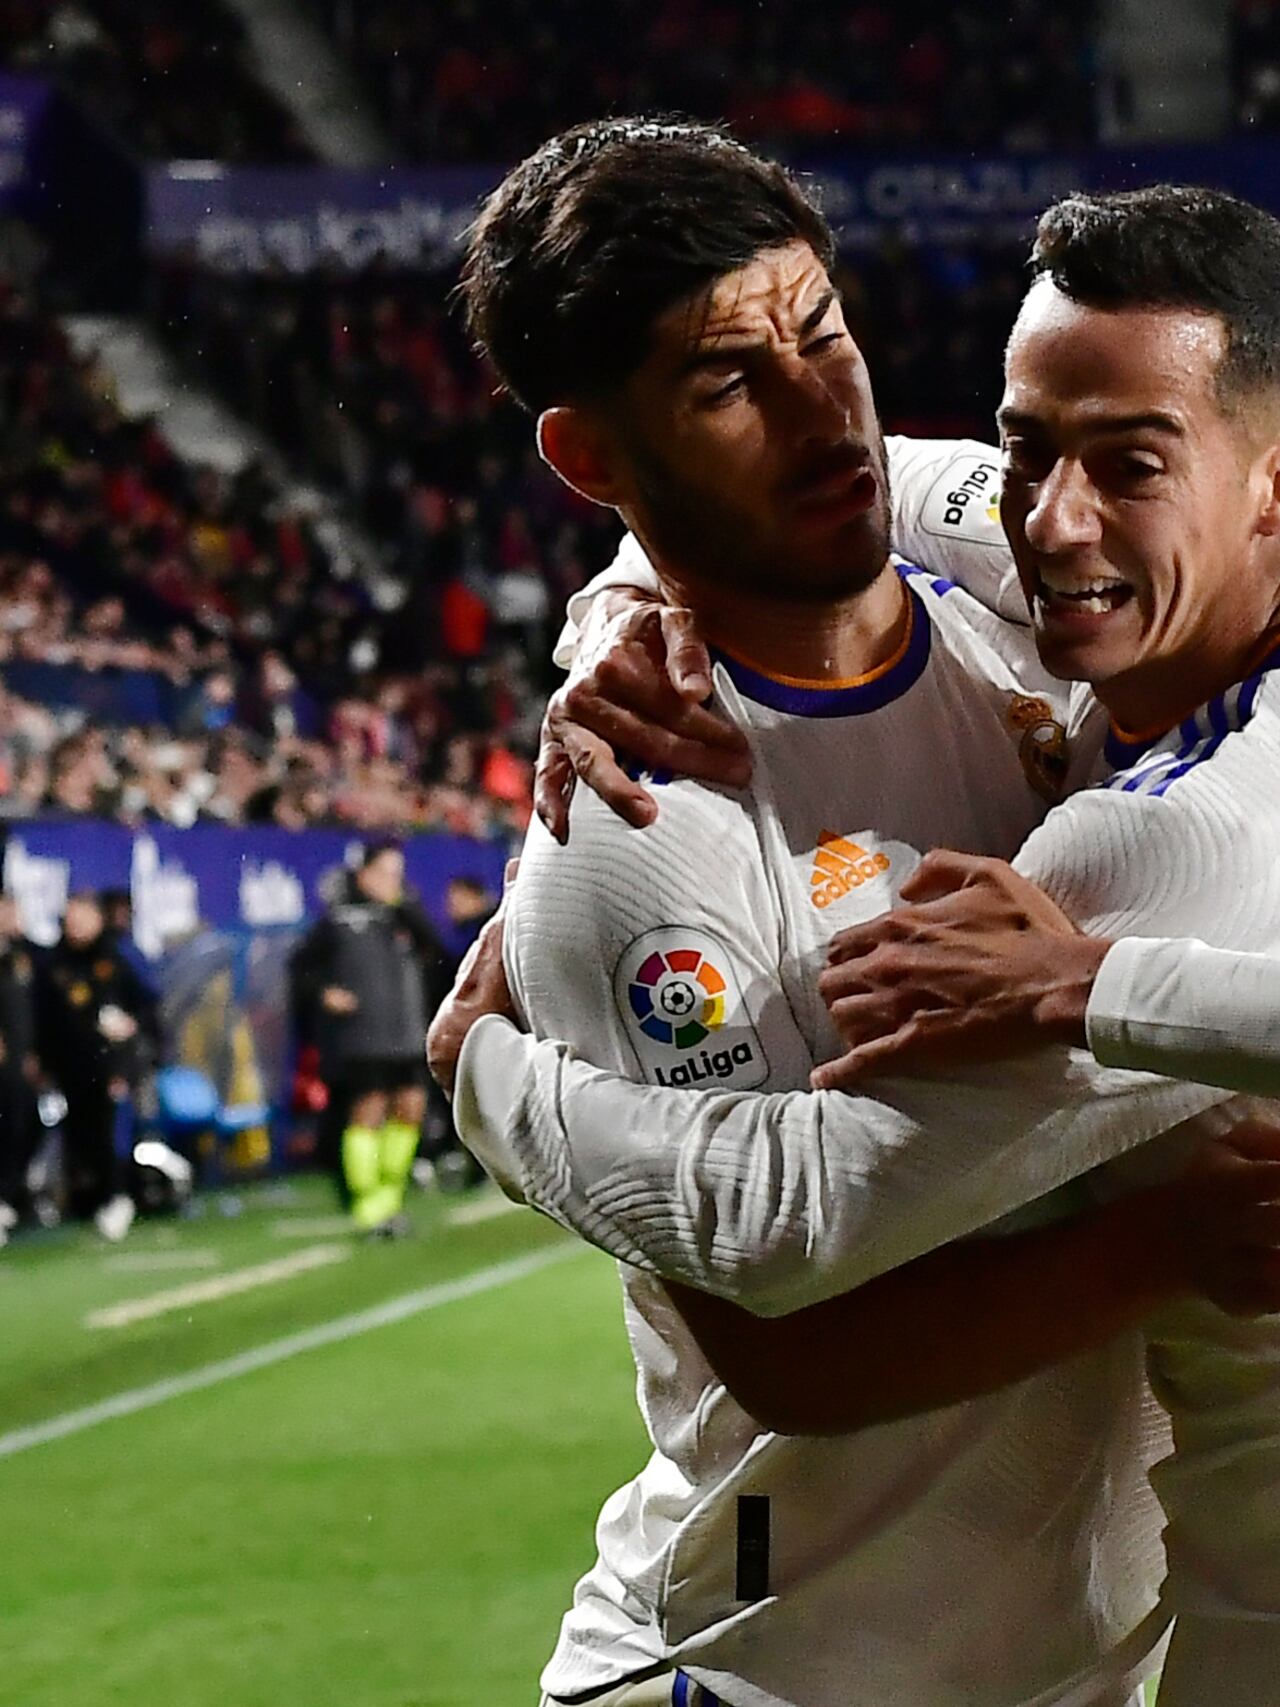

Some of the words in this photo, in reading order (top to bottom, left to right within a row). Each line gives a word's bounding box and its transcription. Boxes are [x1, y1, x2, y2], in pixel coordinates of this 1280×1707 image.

[943, 463, 998, 525] LaLiga
[811, 852, 890, 909] adidas
[654, 1042, 753, 1087] LaLiga
